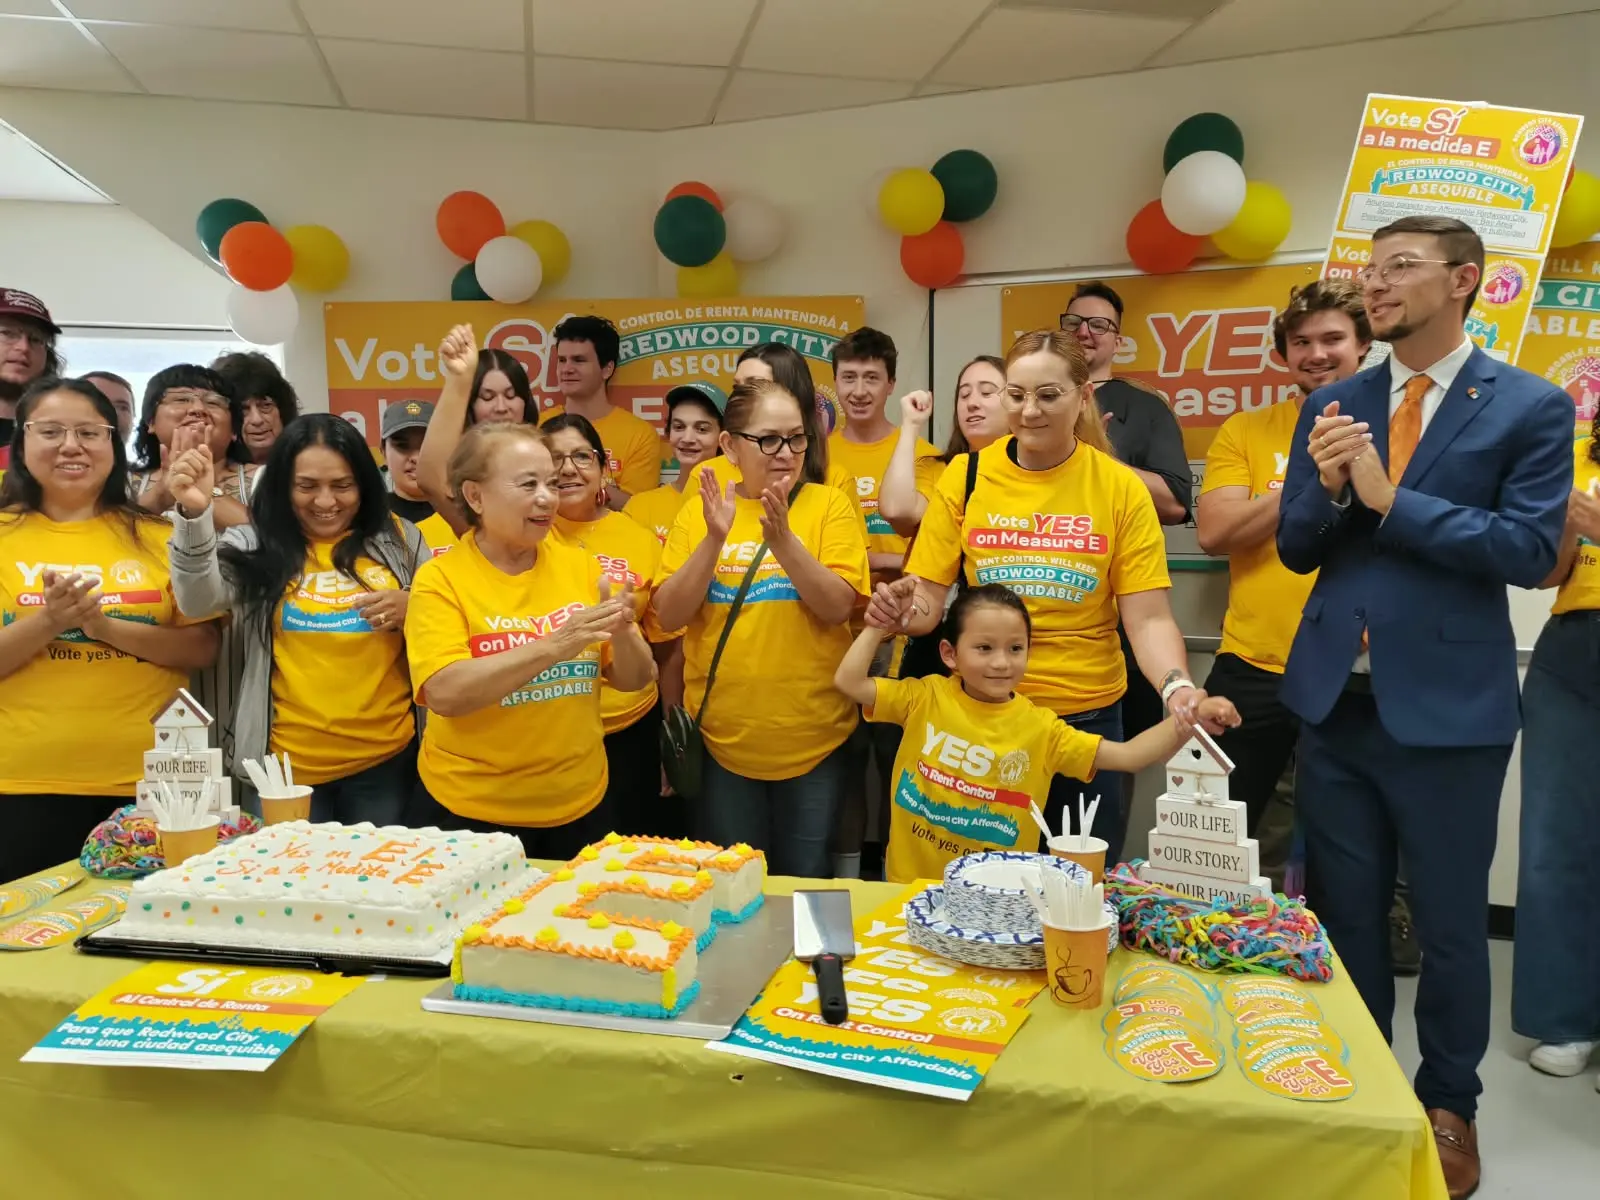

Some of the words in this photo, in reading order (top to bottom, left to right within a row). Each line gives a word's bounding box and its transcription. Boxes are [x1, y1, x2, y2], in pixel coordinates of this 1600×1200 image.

[1372, 108, 1422, 128] Vote
[1363, 133, 1376, 145] a
[1379, 131, 1396, 147] la
[1400, 136, 1473, 155] medida
[1476, 141, 1492, 157] E
[1393, 167, 1478, 184] REDWOOD
[1482, 175, 1520, 197] CITY
[1408, 183, 1495, 203] ASEQUIBLE
[1335, 245, 1371, 261] Vot
[1328, 267, 1352, 280] on
[1547, 258, 1583, 273] ILL
[1557, 285, 1600, 307] CI
[619, 308, 682, 330] CONTROL
[685, 306, 702, 319] DE
[705, 306, 748, 318] RENTA
[752, 306, 836, 330] MANTENDRÁ
[838, 321, 849, 332] A
[619, 327, 760, 360] REDWOOD
[652, 354, 738, 380] ASEQU
[987, 513, 1029, 528] Vote
[1033, 513, 1092, 536] YES
[976, 534, 997, 545] on
[1001, 531, 1085, 549] Measure
[1089, 536, 1100, 550] E
[594, 554, 629, 571] ES
[733, 565, 748, 573] Ren
[976, 556, 1000, 567] RENT
[1002, 555, 1048, 564] CONTROL
[1050, 556, 1073, 567] WILL
[1075, 562, 1097, 574] KEEP
[980, 567, 1056, 582] REDWOOD
[1060, 573, 1095, 590] CITY
[19, 594, 40, 605] On
[298, 590, 311, 600] On
[313, 593, 336, 605] Rent
[287, 615, 306, 627] Keep
[307, 619, 342, 630] Redwood
[342, 616, 357, 629] City
[485, 615, 529, 631] Vote
[48, 647, 81, 660] Vote
[87, 649, 111, 663] yes
[479, 638, 505, 652] on
[573, 664, 598, 678] CITY
[500, 681, 593, 707] AFFORDABLE
[921, 721, 995, 777] YES
[156, 761, 180, 773] OUR
[182, 761, 209, 773] LIFE.
[918, 761, 928, 776] On
[929, 769, 955, 787] Rent
[955, 781, 997, 801] Control
[901, 788, 918, 808] Keep
[919, 804, 950, 822] Redwood
[951, 816, 970, 827] City
[971, 817, 1017, 838] Affordable
[1170, 811, 1199, 829] OUR
[1201, 815, 1234, 834] LIFE.
[911, 822, 936, 843] Vote
[938, 839, 960, 854] yes
[325, 849, 352, 860] on
[1164, 846, 1193, 864] OUR
[1195, 851, 1243, 872] STORY.
[264, 866, 281, 876] a
[393, 863, 445, 884] E
[1176, 882, 1205, 901] OUR
[156, 968, 246, 996] Sí
[843, 966, 929, 993] ES
[116, 993, 138, 1004] Al
[137, 995, 198, 1008] Control
[197, 998, 217, 1009] de
[220, 999, 271, 1012] Renta
[56, 1022, 95, 1035] Para
[102, 1026, 133, 1039] que
[140, 1024, 221, 1041] Redwood
[225, 1030, 260, 1045] City
[775, 1007, 805, 1020] On
[859, 1023, 934, 1044] Control
[61, 1036, 92, 1046] sea
[96, 1036, 129, 1048] una
[133, 1037, 195, 1051] ciudad
[194, 1041, 281, 1057] asequible
[734, 1028, 764, 1047] Keep
[765, 1038, 838, 1060] Redwood
[841, 1052, 876, 1065] City
[879, 1054, 974, 1081] Affordable
[1131, 1048, 1171, 1065] Vote
[1169, 1041, 1216, 1067] E
[1146, 1058, 1181, 1076] Yes
[1251, 1047, 1291, 1071] REDWOOD
[1170, 1066, 1191, 1076] on
[1264, 1065, 1305, 1083] Vote
[1301, 1057, 1352, 1087] E
[1282, 1075, 1318, 1094] Yes
[1309, 1084, 1331, 1095] on
